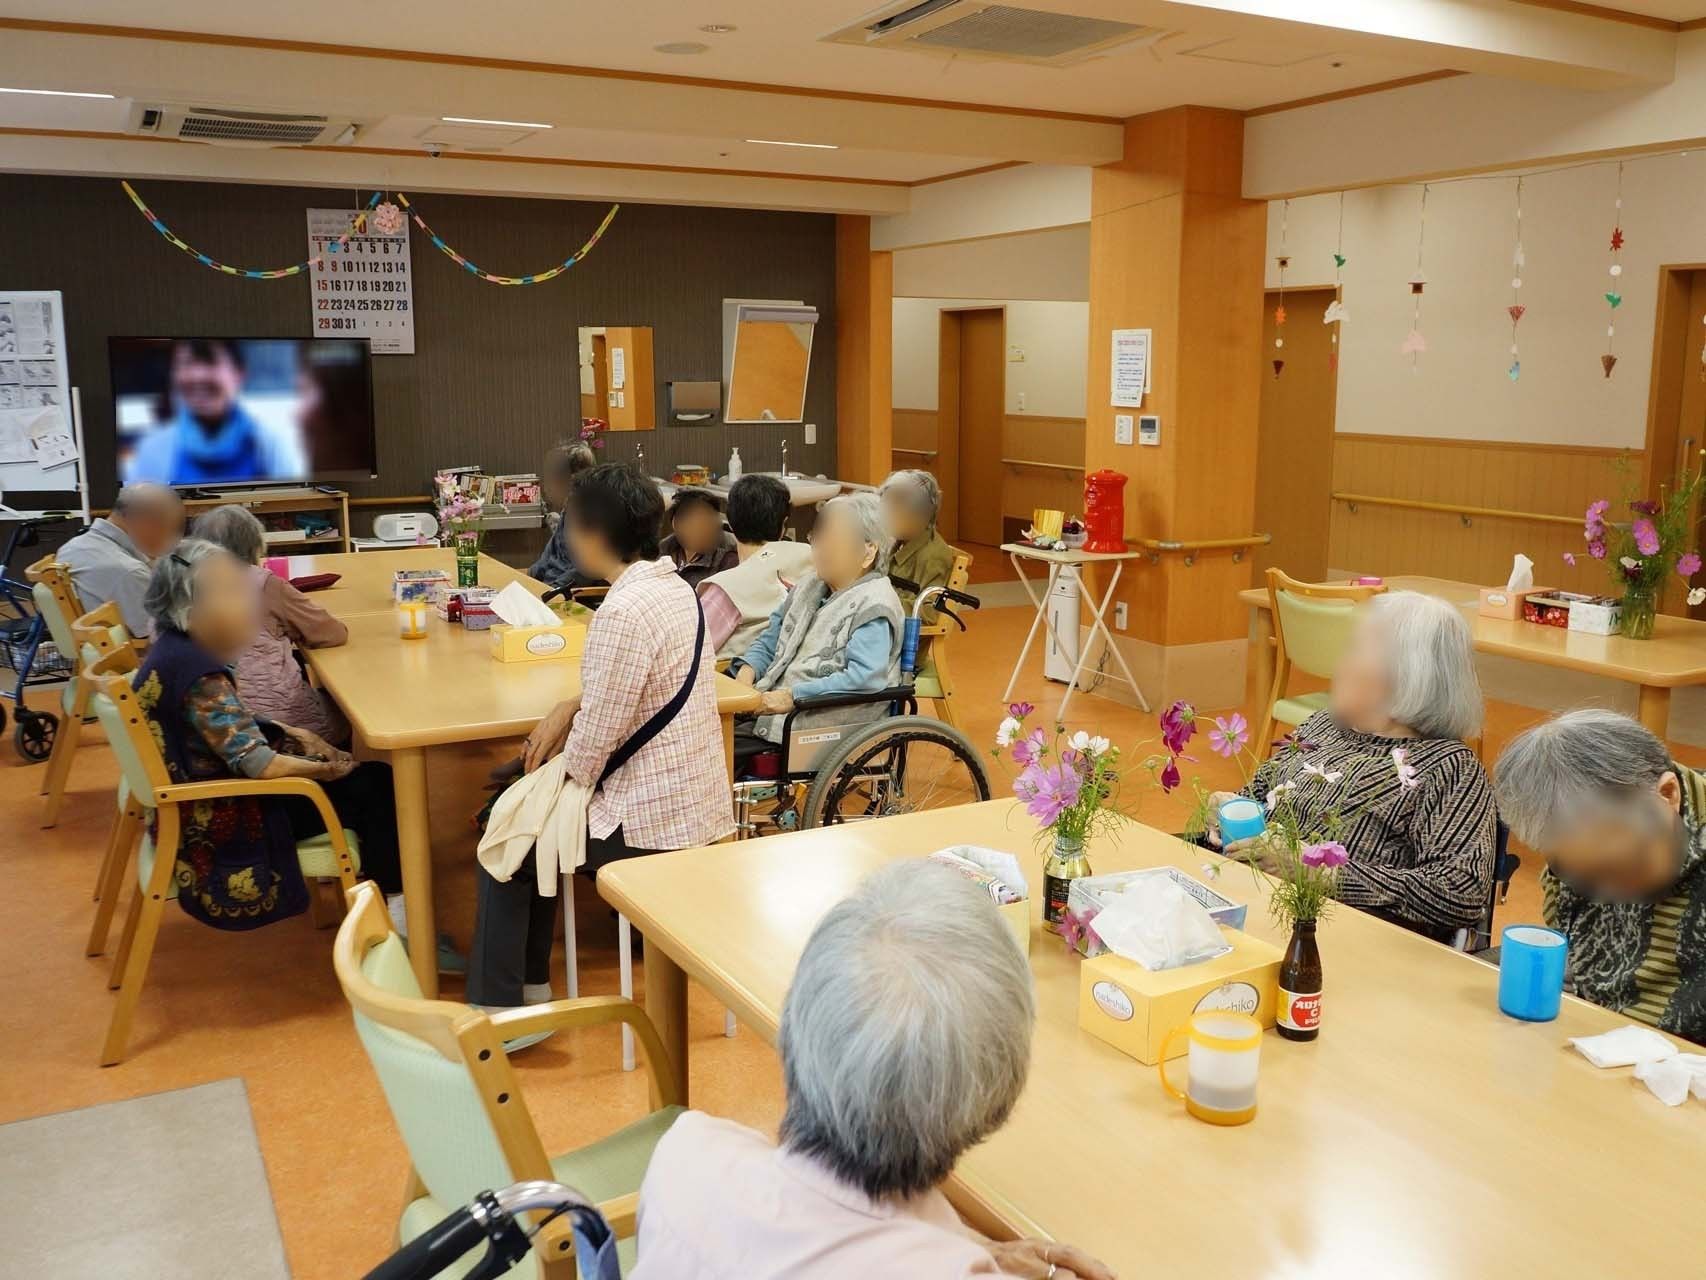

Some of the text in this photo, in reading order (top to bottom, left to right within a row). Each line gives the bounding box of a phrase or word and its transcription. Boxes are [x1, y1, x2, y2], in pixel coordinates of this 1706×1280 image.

[318, 241, 322, 252] 1
[343, 242, 350, 253] 3
[356, 242, 363, 253] 4
[370, 243, 376, 253] 5
[383, 243, 389, 254] 6
[395, 243, 402, 254] 7
[318, 261, 406, 273] 8 9 10 11 12 13 14
[317, 280, 407, 292] 15 16 17 18 19 20 21
[318, 299, 408, 311] 22 23 24 25 26 27 28
[318, 318, 330, 329] 29
[332, 318, 343, 329] 30
[345, 318, 357, 329] 31
